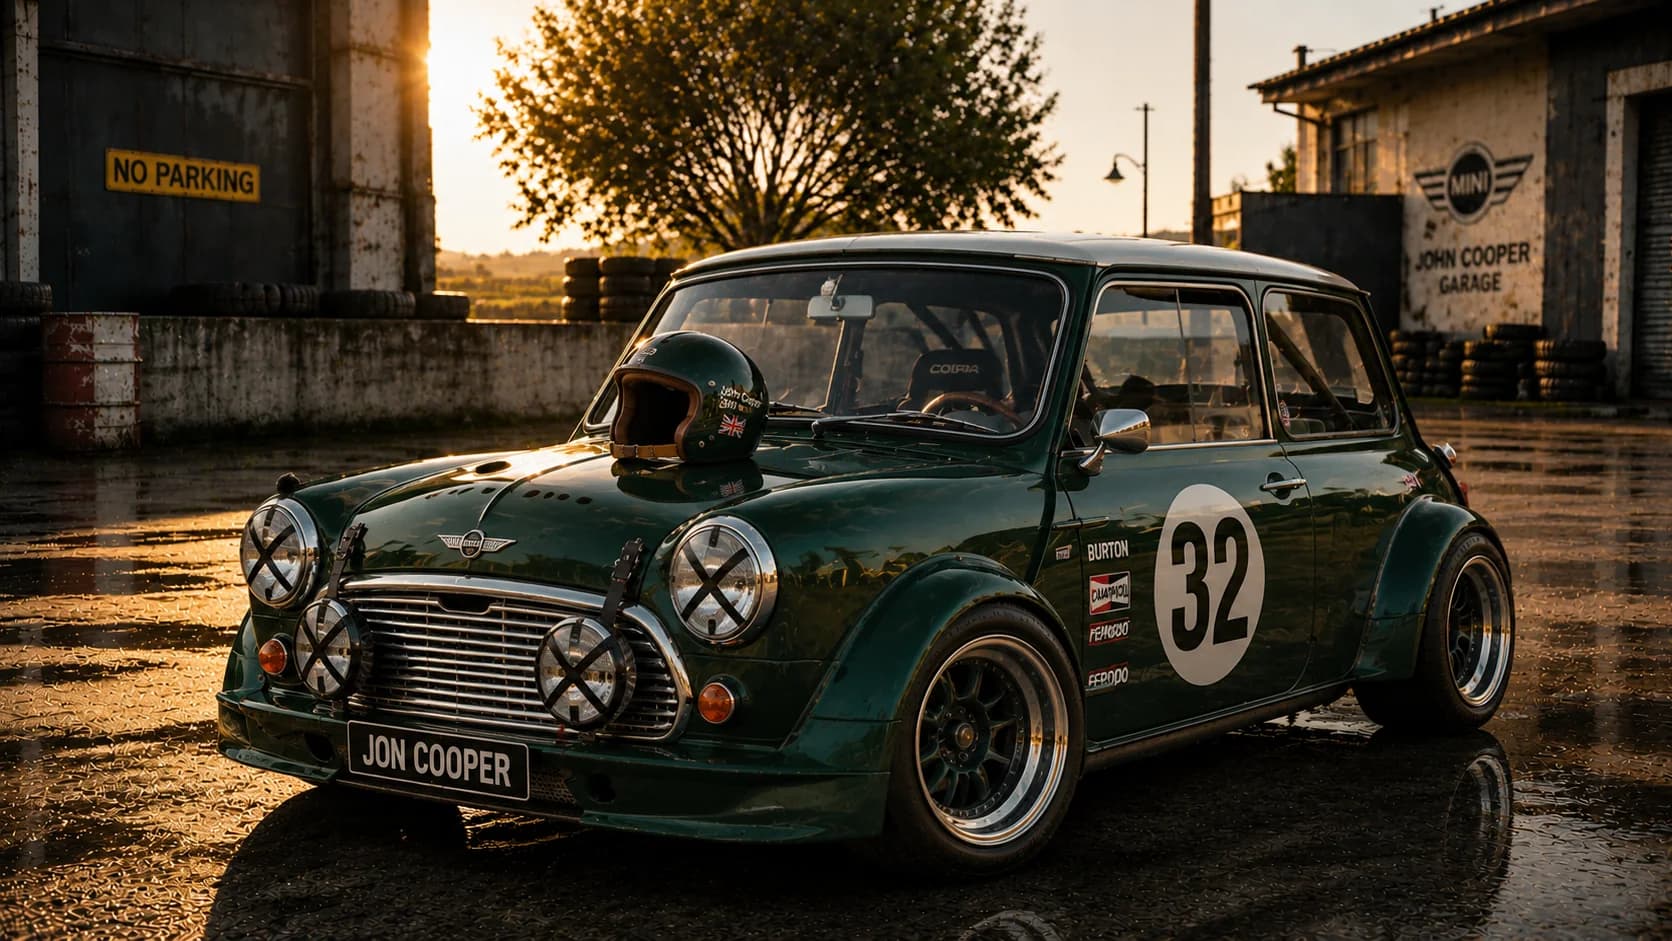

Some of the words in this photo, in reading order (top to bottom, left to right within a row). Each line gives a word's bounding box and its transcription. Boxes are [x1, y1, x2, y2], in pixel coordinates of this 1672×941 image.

[113, 157, 148, 185] NO
[155, 161, 254, 195] PARKING
[1450, 170, 1490, 197] MINI
[1415, 249, 1456, 271] JOHN
[1460, 242, 1531, 268] COOPER
[1439, 272, 1503, 295] GARAGE
[1087, 539, 1129, 562] BURTON
[1171, 516, 1249, 652] 32
[362, 733, 406, 772] JON
[412, 740, 512, 788] COOPER
